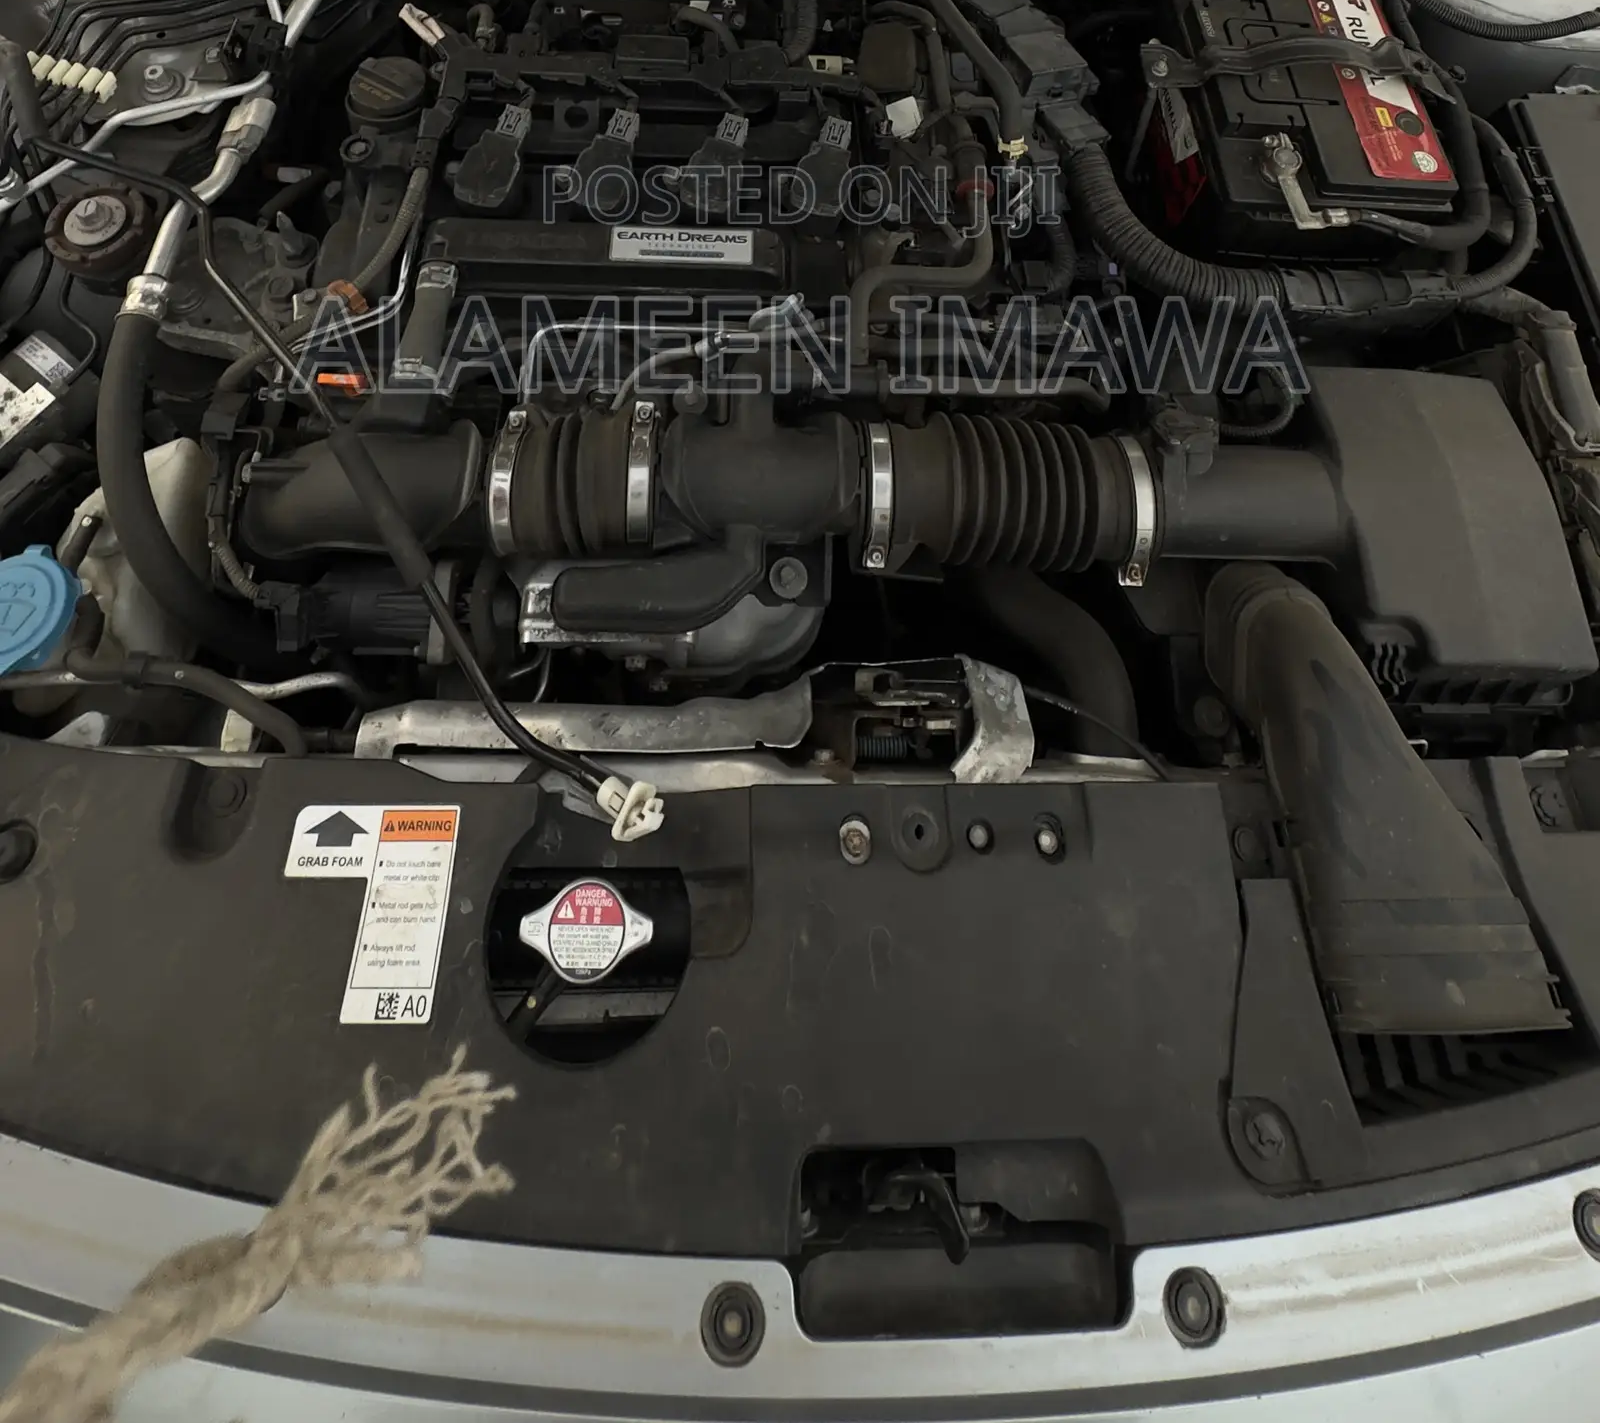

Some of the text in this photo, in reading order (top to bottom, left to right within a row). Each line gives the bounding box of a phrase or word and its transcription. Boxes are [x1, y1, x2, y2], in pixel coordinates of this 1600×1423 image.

[617, 231, 748, 244] EARTH DREAMS
[397, 820, 452, 832] WARNING
[297, 856, 363, 867] GRAB FOAM
[575, 888, 607, 898] DANGER
[400, 995, 428, 1018] A0
